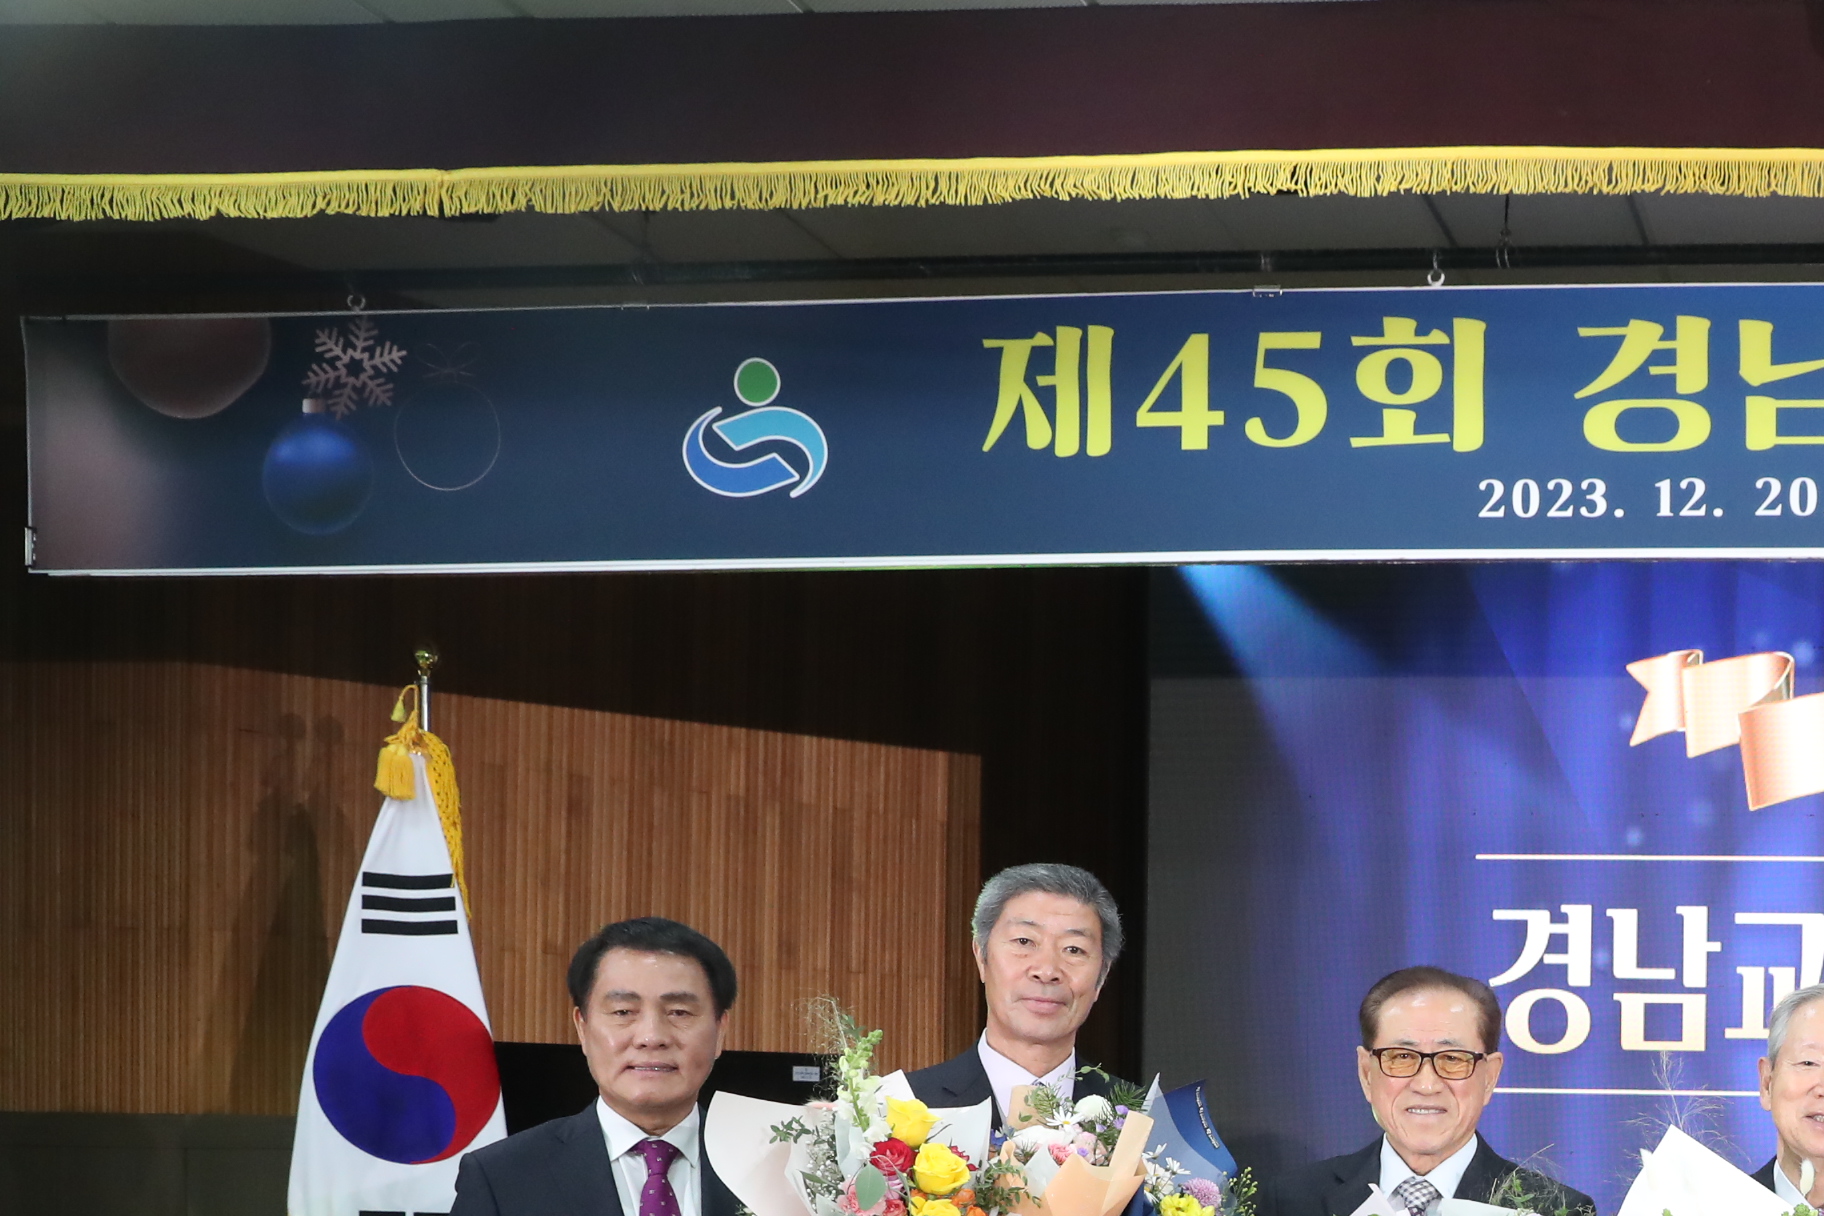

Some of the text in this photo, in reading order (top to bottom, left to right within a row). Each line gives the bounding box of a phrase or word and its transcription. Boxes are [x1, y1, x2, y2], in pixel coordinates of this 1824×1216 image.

[982, 316, 1487, 458] 제45회
[1478, 478, 1625, 518] 2023.
[1654, 477, 1724, 518] 12.
